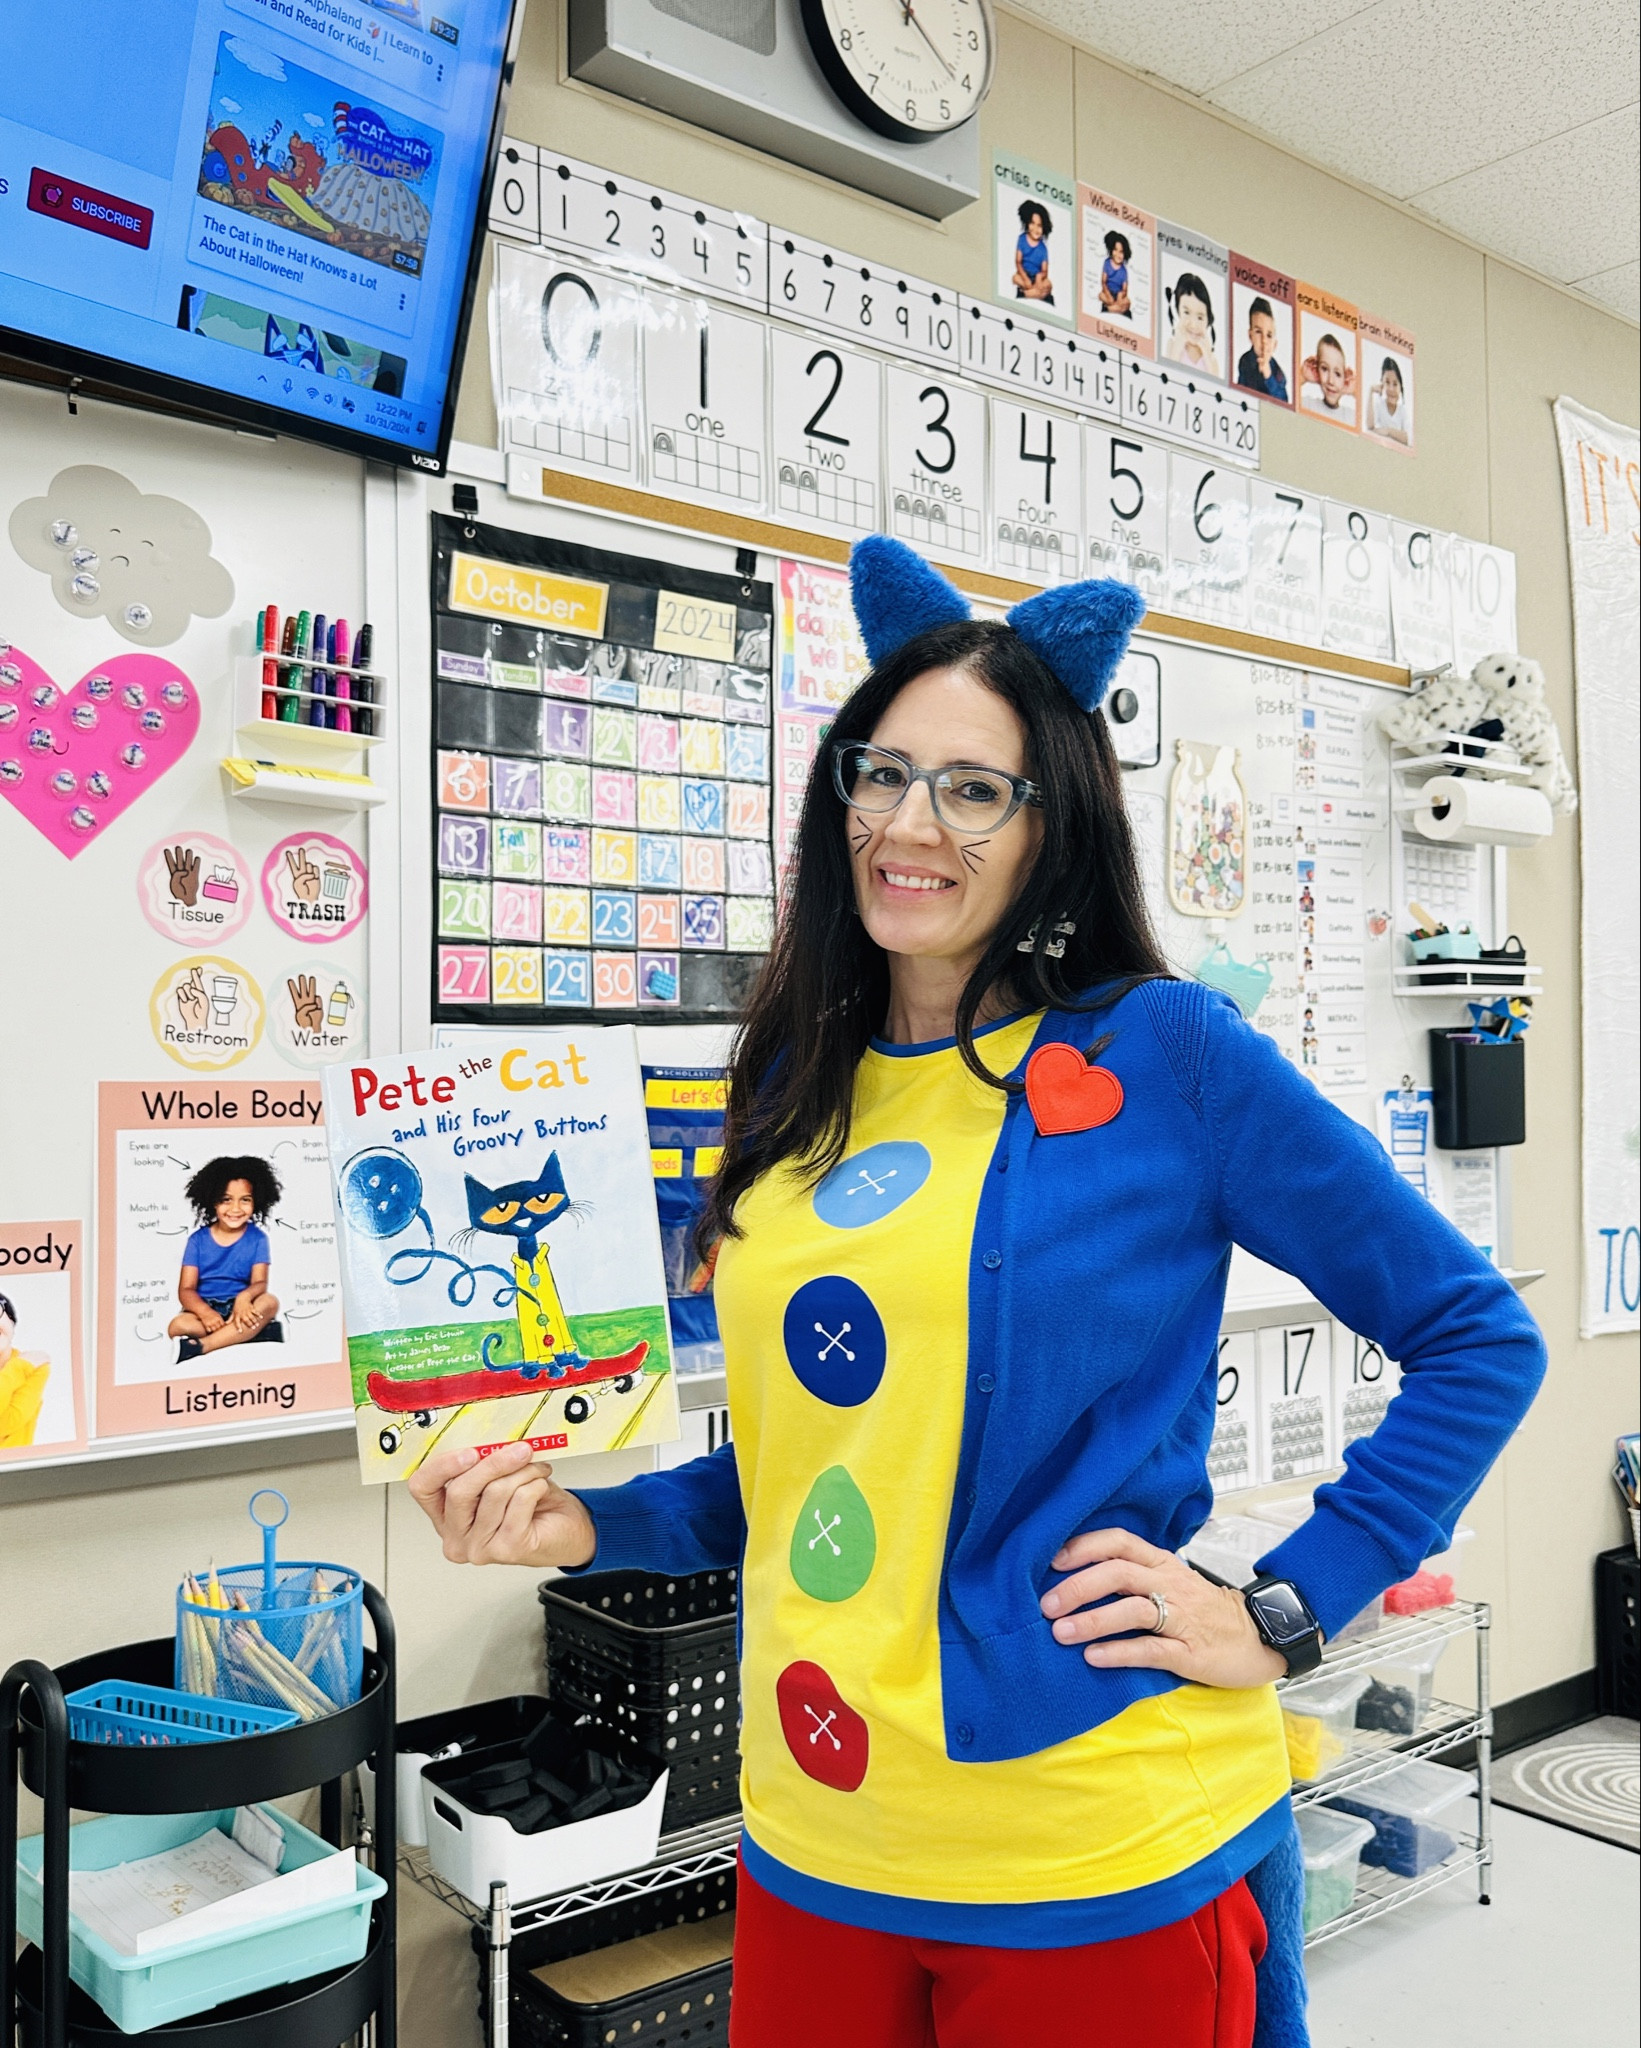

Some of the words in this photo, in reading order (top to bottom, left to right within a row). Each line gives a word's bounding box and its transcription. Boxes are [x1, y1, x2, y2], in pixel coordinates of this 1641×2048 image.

[270, 0, 293, 18] and
[296, 9, 326, 33] Read
[328, 24, 345, 42] for
[347, 34, 372, 56] Kids
[840, 28, 853, 51] 8
[967, 30, 979, 51] 3
[390, 34, 421, 59] Learn
[421, 51, 434, 65] to
[867, 72, 880, 95] 7
[960, 73, 972, 93] 4
[905, 98, 917, 122] 6
[939, 98, 951, 120] 5
[360, 120, 387, 141] CAT
[403, 140, 430, 160] HAT
[994, 162, 1030, 188] criss
[1034, 177, 1074, 206] cross
[71, 197, 142, 233] SUBSCRIBE
[1089, 191, 1120, 216] Whole
[1121, 204, 1146, 230] Body
[199, 236, 237, 259] About
[238, 249, 304, 283] Halloween!
[203, 214, 227, 234] The
[229, 225, 250, 244] Cat
[252, 233, 265, 247] in
[266, 238, 286, 256] the
[287, 246, 308, 265] Hat
[310, 255, 348, 279] Knows
[350, 273, 358, 282] a
[359, 273, 378, 290] Lot
[1157, 229, 1183, 250] eyes
[1185, 240, 1230, 274] watching
[1234, 264, 1266, 289] voice
[1269, 278, 1290, 299] off
[503, 178, 524, 215] 0
[561, 193, 567, 231] 1
[605, 209, 620, 246] 2
[650, 224, 666, 258] 3
[693, 236, 709, 274] 4
[736, 250, 752, 287] 5
[783, 268, 797, 301] 6
[822, 279, 836, 313] 7
[859, 293, 873, 326] 8
[895, 305, 909, 340] 9
[928, 314, 953, 350] 10
[968, 329, 986, 366] 11
[1000, 340, 1021, 376] 12
[1033, 350, 1054, 385] 13
[1064, 360, 1084, 396] 14
[1095, 371, 1115, 405] 15
[1129, 380, 1149, 417] 16
[1158, 390, 1176, 426] 17
[1184, 399, 1204, 434] 18
[1211, 408, 1231, 442] 19
[1234, 421, 1256, 451] 20
[541, 271, 602, 373] 0
[1296, 291, 1320, 309] ears
[1321, 297, 1358, 331] listening
[1095, 320, 1138, 351] Listening
[1358, 315, 1382, 337] brain
[1383, 326, 1415, 355] thinking
[804, 349, 850, 447] 2
[685, 412, 726, 439] one
[915, 386, 956, 474] 3
[411, 454, 440, 471] VIZIO
[804, 440, 846, 472] two
[1019, 411, 1057, 505] 4
[911, 468, 962, 503] three
[1109, 437, 1145, 521] 5
[1017, 498, 1057, 526] four
[1193, 469, 1223, 544] 6
[1111, 520, 1141, 546] five
[1274, 492, 1304, 566] 7
[1345, 511, 1371, 582] 8
[465, 567, 586, 621] October
[661, 601, 734, 645] 2024
[446, 657, 480, 675] Sunday
[602, 719, 624, 758] 2
[788, 726, 805, 744] 10
[448, 761, 477, 801] 6
[788, 762, 806, 780] 20
[556, 770, 575, 809] 8
[602, 780, 622, 818] 9
[446, 824, 479, 865] 13
[598, 837, 628, 875] 16
[688, 844, 714, 882] 18
[168, 902, 225, 925] Tissue
[286, 902, 346, 922] TRASH
[443, 889, 488, 928] 20
[549, 898, 587, 936] 22
[595, 898, 634, 937] 23
[640, 901, 677, 940] 24
[442, 955, 488, 995] 27
[495, 955, 538, 995] 28
[548, 958, 588, 997] 29
[596, 958, 636, 998] 30
[164, 1024, 249, 1048] Restroom
[291, 1031, 349, 1048] Water
[350, 1064, 457, 1118] Pete
[458, 1054, 493, 1080] the
[499, 1043, 590, 1093] Cat
[671, 1087, 710, 1104] Let's
[141, 1090, 239, 1121] Whole
[251, 1089, 323, 1125] Body
[391, 1117, 427, 1143] and
[436, 1109, 462, 1134] His
[472, 1107, 511, 1128] Four
[129, 1141, 151, 1152] Eyes
[153, 1142, 170, 1150] are
[452, 1127, 524, 1157] Groovy
[534, 1113, 608, 1140] Buttons
[134, 1157, 165, 1168] looking
[129, 1202, 159, 1213] Mouth
[138, 1218, 161, 1230] quiet
[300, 1220, 320, 1230] Ears
[321, 1220, 336, 1229] are
[301, 1235, 335, 1246] listening
[125, 1278, 147, 1290] Legs
[149, 1278, 167, 1287] are
[294, 1281, 319, 1291] Hands
[1597, 1225, 1640, 1313] TO
[122, 1294, 151, 1304] folded
[153, 1292, 170, 1302] and
[137, 1309, 154, 1320] still
[306, 1294, 336, 1307] myself
[383, 1337, 413, 1347] Written
[413, 1335, 424, 1344] by
[424, 1331, 438, 1341] Eric
[440, 1328, 465, 1339] Litwin
[384, 1351, 397, 1361] Art
[409, 1347, 431, 1357] James
[432, 1343, 451, 1353] Dean
[426, 1357, 444, 1367] Pete
[445, 1355, 460, 1366] the
[1282, 1327, 1315, 1396] 17
[1353, 1333, 1384, 1384] 18
[165, 1382, 297, 1415] Listening
[1269, 1394, 1322, 1415] seventeen
